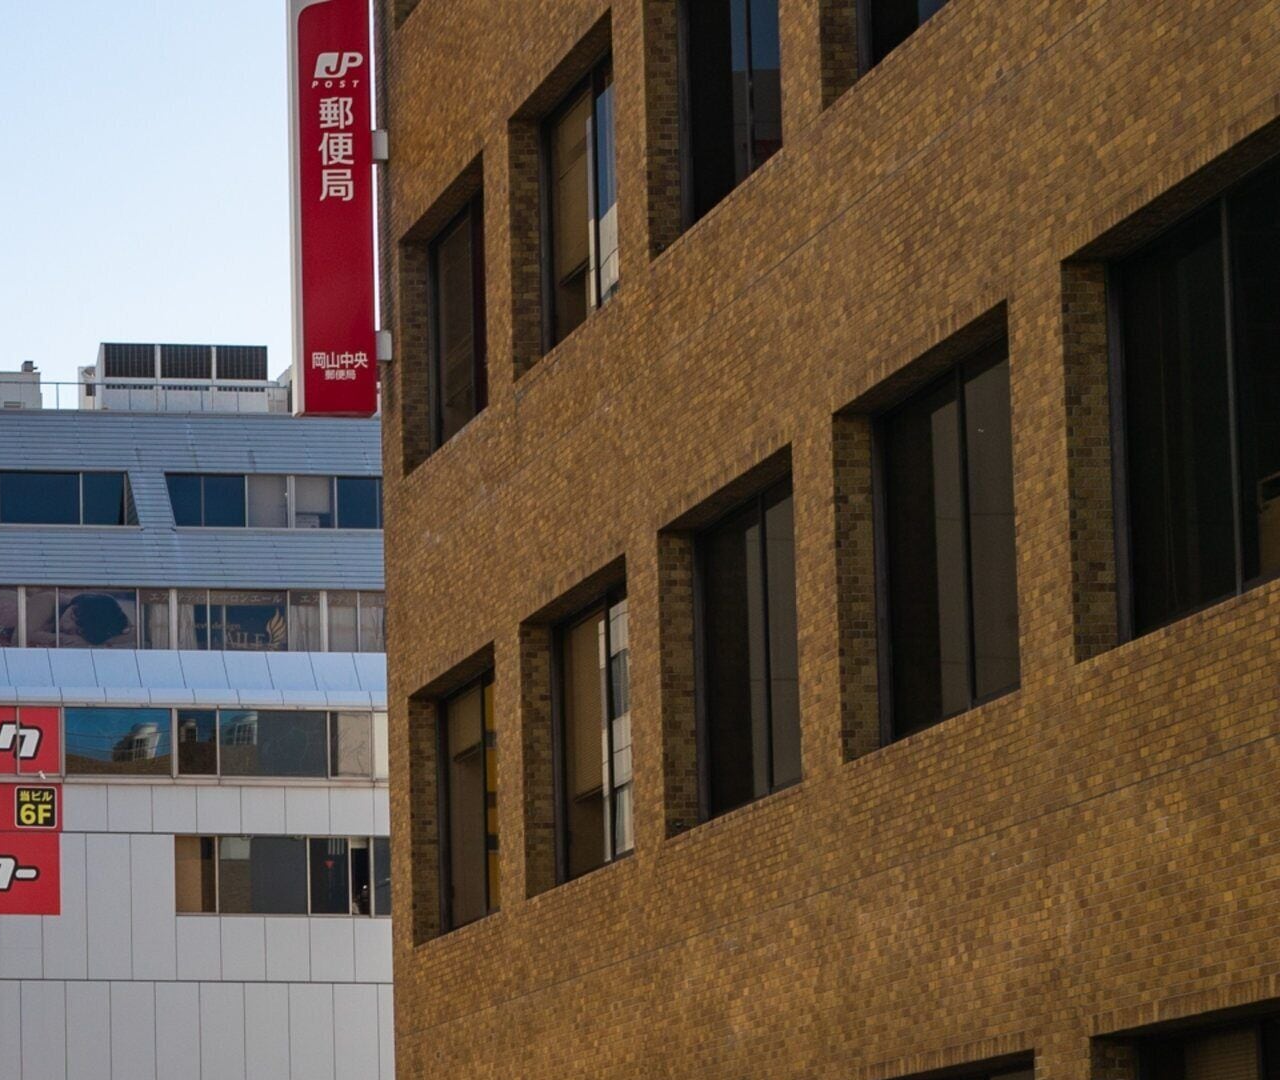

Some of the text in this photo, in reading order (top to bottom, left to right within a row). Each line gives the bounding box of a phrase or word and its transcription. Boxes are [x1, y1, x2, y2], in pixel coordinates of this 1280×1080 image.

[311, 80, 360, 89] POST
[318, 96, 355, 202] 郵便局
[312, 351, 369, 369] 岡山中央
[324, 369, 357, 381] 郵便局
[19, 790, 53, 802] 当ビル
[20, 803, 52, 825] 6F
